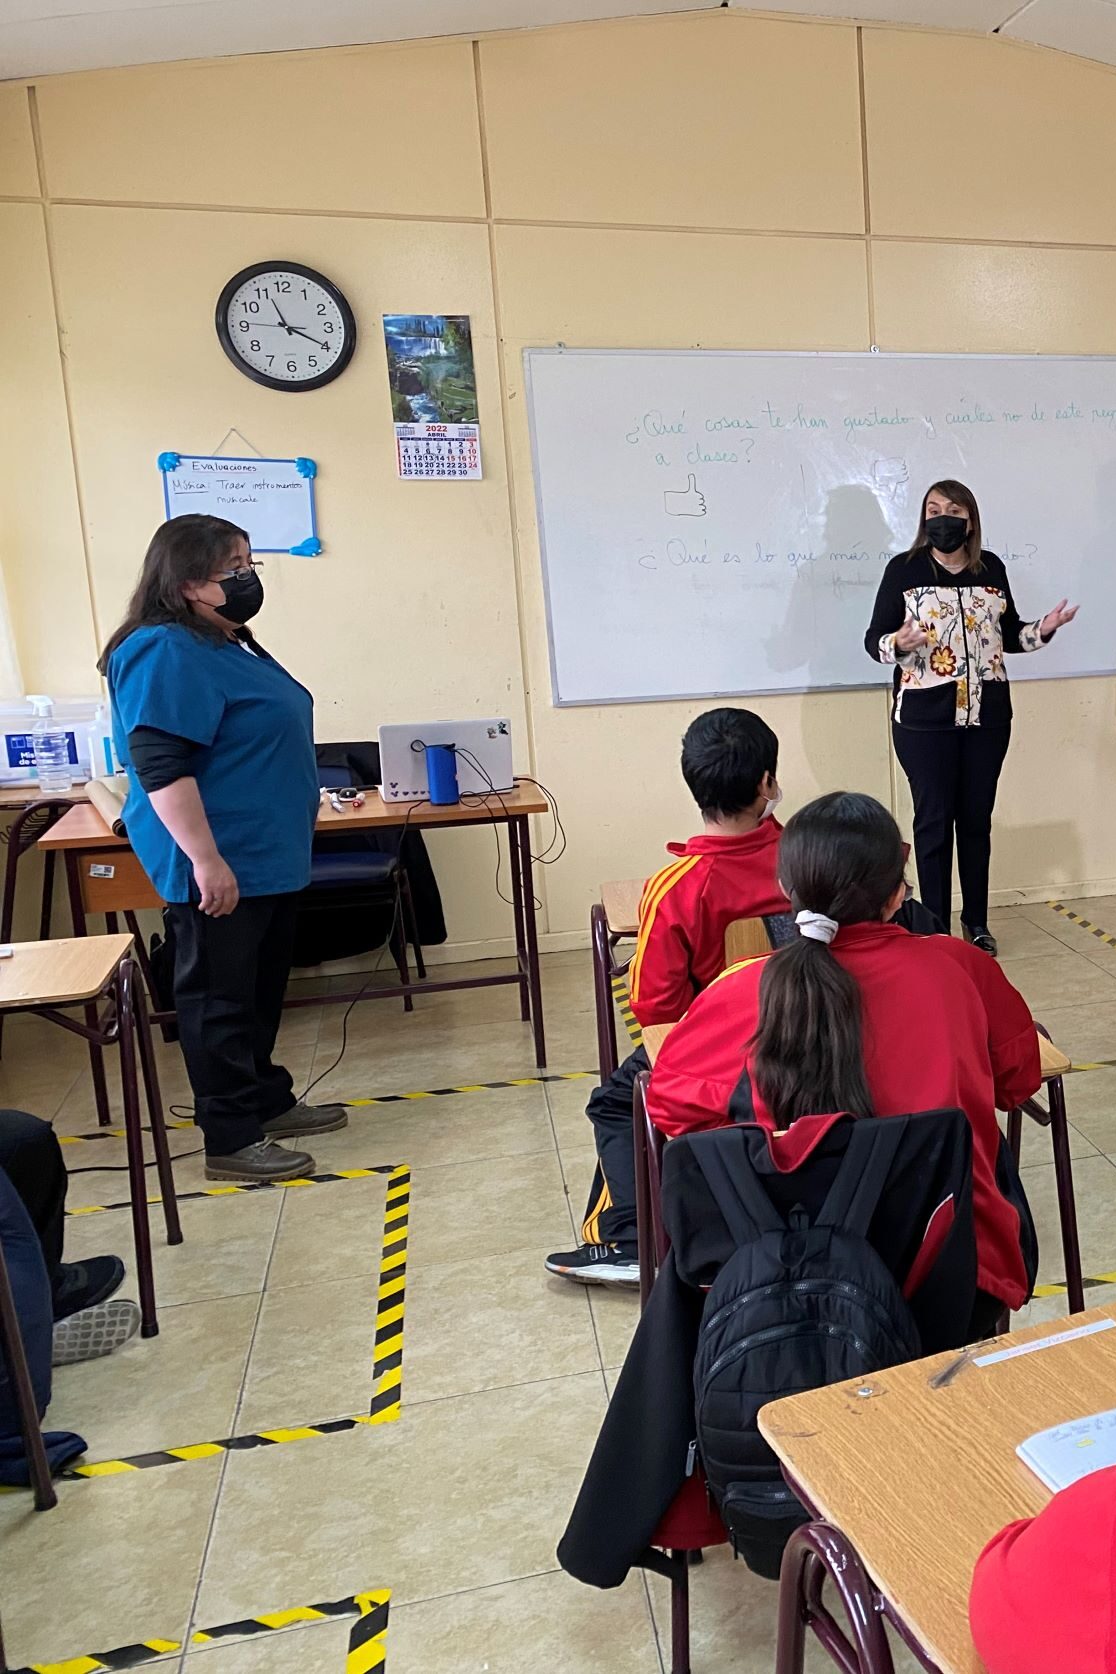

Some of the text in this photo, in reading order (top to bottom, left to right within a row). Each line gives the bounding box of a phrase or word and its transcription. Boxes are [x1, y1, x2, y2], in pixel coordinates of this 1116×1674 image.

[274, 281, 291, 293] 12
[254, 288, 269, 300] 11
[301, 289, 307, 301] 1
[241, 302, 259, 313] 10
[316, 304, 326, 316] 2
[239, 320, 249, 332] 9
[324, 322, 334, 334] 3
[250, 340, 261, 352] 8
[321, 341, 331, 352] 4
[265, 355, 275, 367] 7
[287, 361, 297, 372] 6
[308, 355, 317, 367] 5
[626, 410, 687, 444] ¿Qué
[705, 416, 760, 432] cosas
[761, 400, 785, 428] te
[793, 403, 828, 428] han
[844, 406, 912, 444] gustado
[924, 416, 938, 440] y
[1004, 412, 1023, 423] no
[1031, 403, 1046, 422] de
[1055, 402, 1084, 420] este
[656, 438, 755, 466] a clases?
[192, 461, 257, 472] Evaluaciones
[216, 479, 246, 490] Traer
[723, 552, 741, 564] es
[754, 542, 777, 564] lo
[788, 552, 818, 578] que
[830, 540, 870, 561] más
